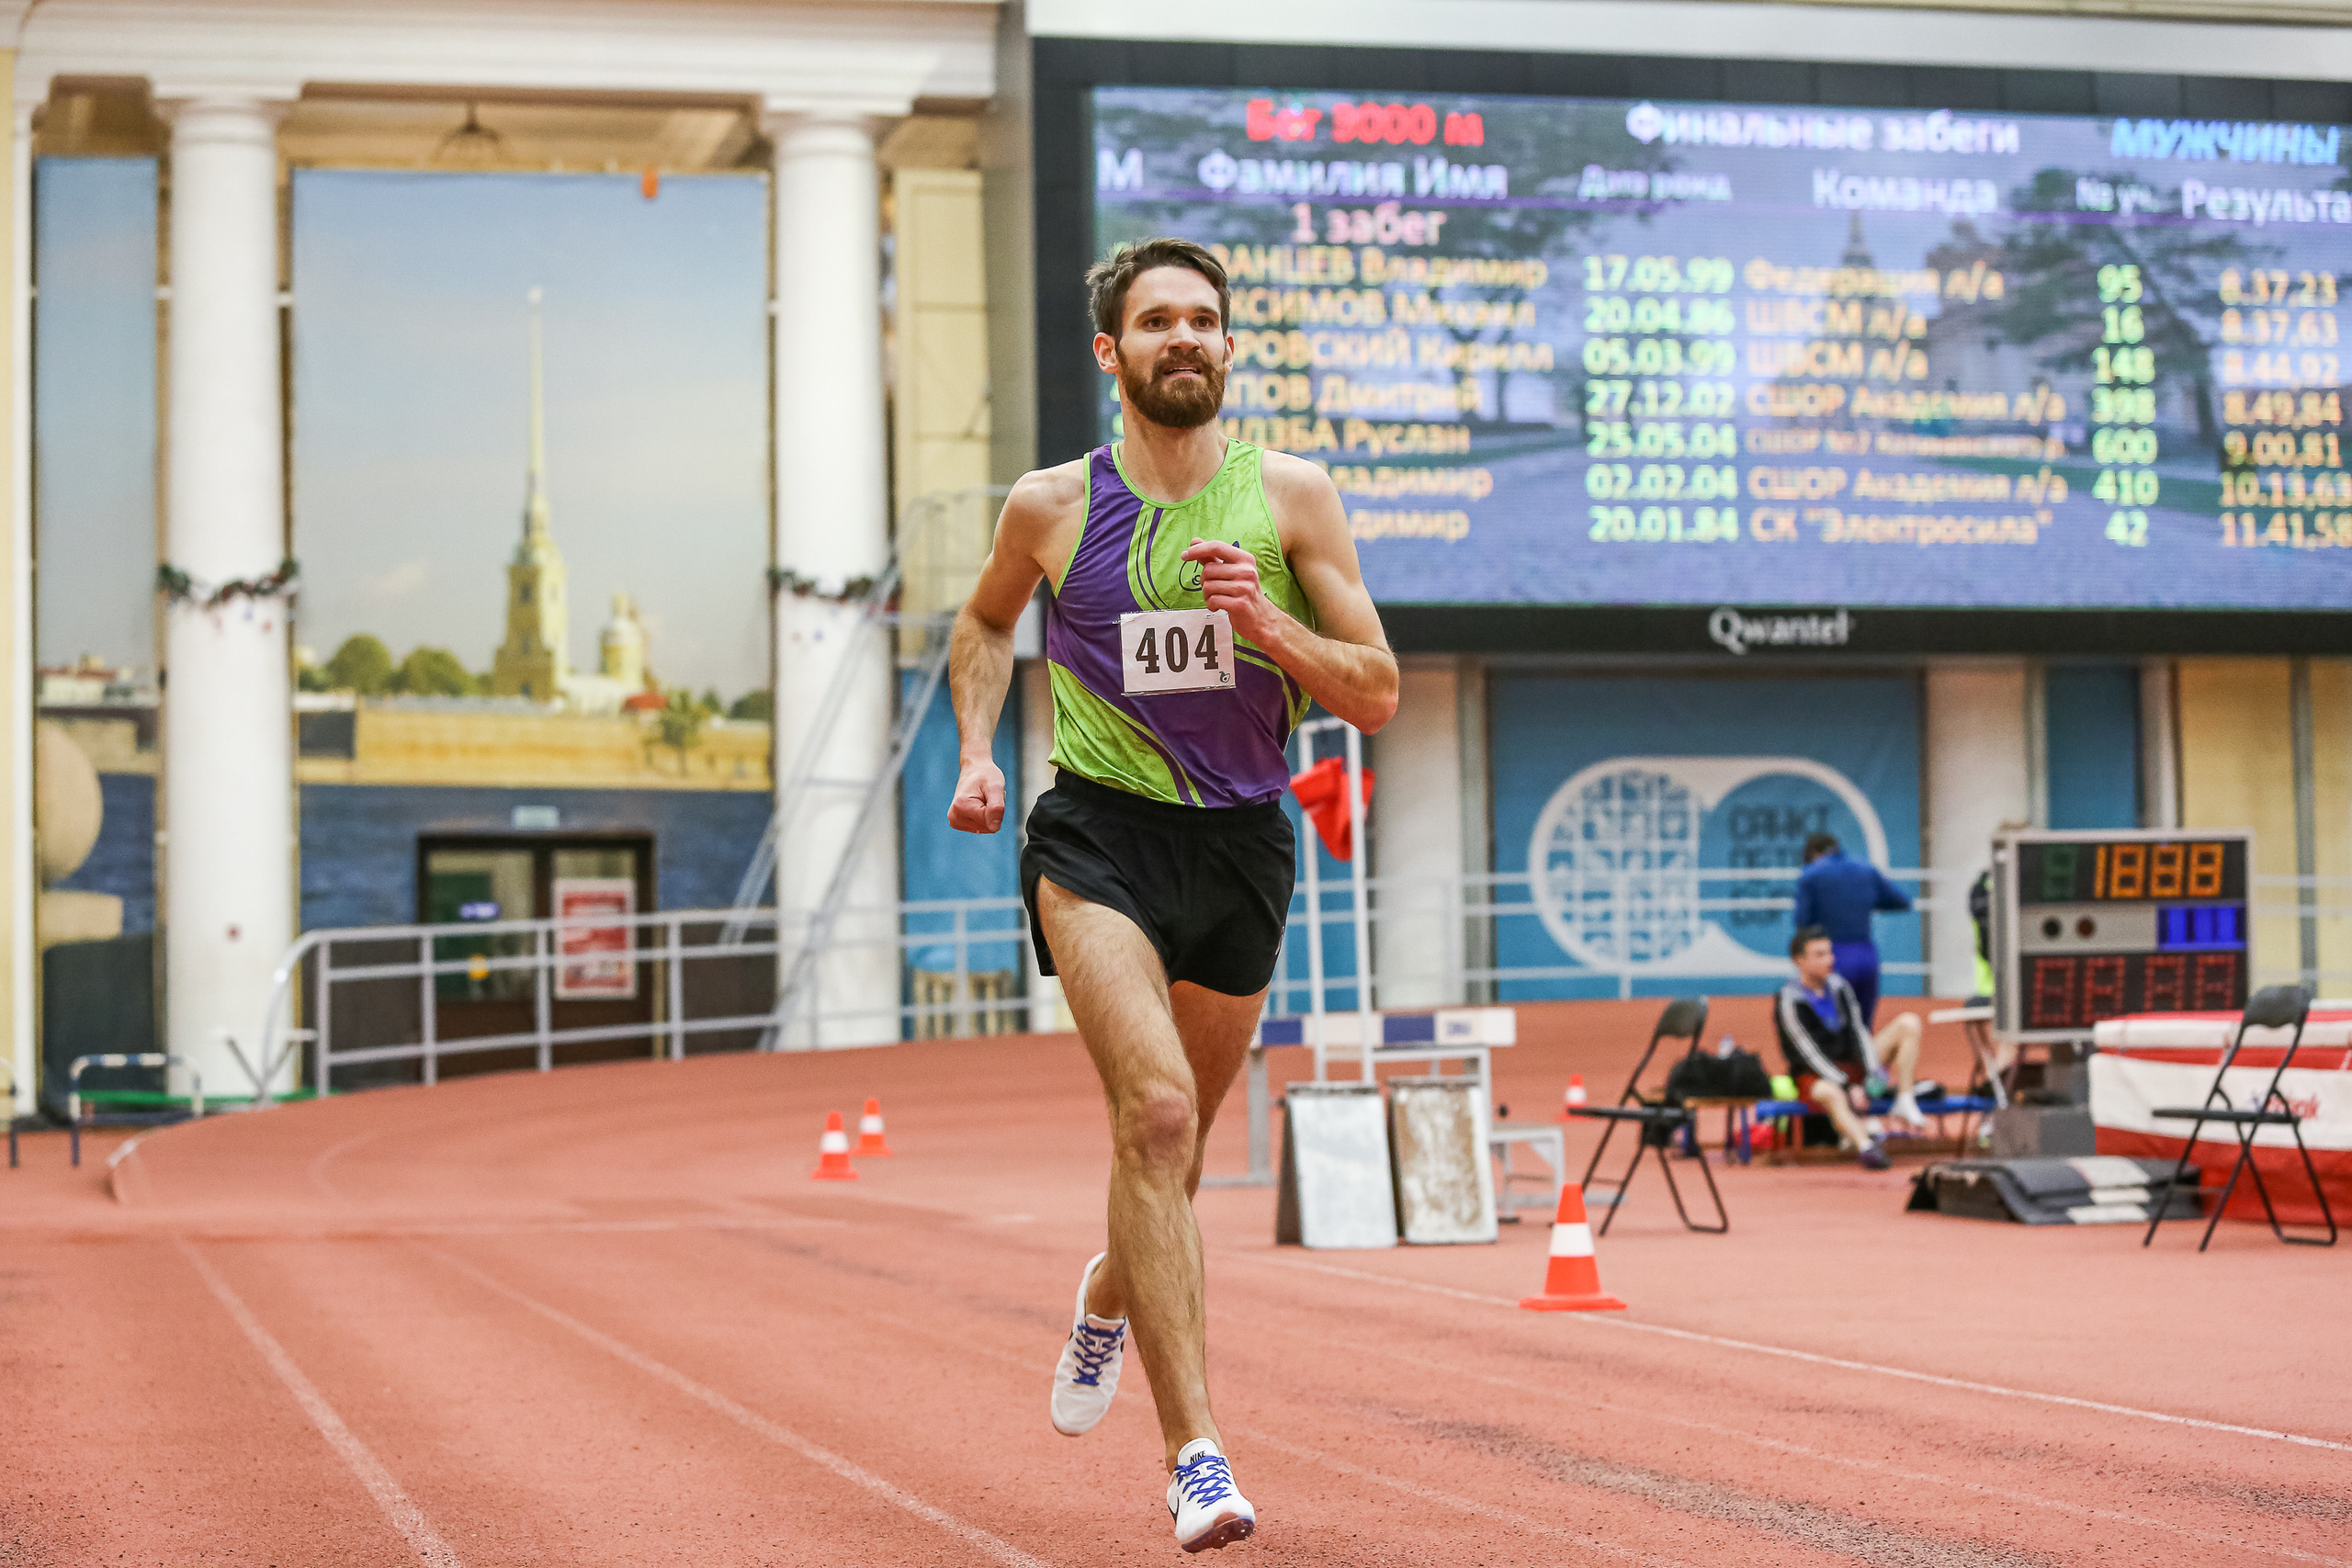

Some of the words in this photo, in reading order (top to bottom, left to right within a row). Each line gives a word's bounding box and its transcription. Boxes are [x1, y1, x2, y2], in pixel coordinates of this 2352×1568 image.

[1626, 101, 1873, 151] Финальные
[1881, 109, 2021, 153] забеги
[2110, 118, 2341, 164] МУЖЧИНЫ
[1197, 148, 1406, 197] Фамилия
[1413, 154, 1510, 200] Имя
[1813, 167, 1998, 215] Команда
[2182, 178, 2352, 226] Результа
[1327, 204, 1447, 245] забег
[1361, 246, 1548, 289] Владимир
[1229, 288, 1386, 326] КСИМОВ
[1232, 328, 1411, 369] РОВСКИЙ
[1417, 334, 1554, 372] Кирилл
[1224, 374, 1311, 412] ПОВ
[1317, 374, 1482, 415] Дмитрий
[1584, 379, 1736, 418] 27.12.02
[1343, 418, 1470, 457] Руслан
[1314, 462, 1494, 501] ладимир
[1584, 463, 1738, 501] 02.02.04
[2091, 468, 2159, 506] 410
[1347, 510, 1470, 543] димир
[1588, 505, 1739, 542] 20.01.84
[2105, 510, 2150, 547] 42
[1136, 625, 1218, 673] 404
[1190, 1450, 1205, 1464] NIKE
